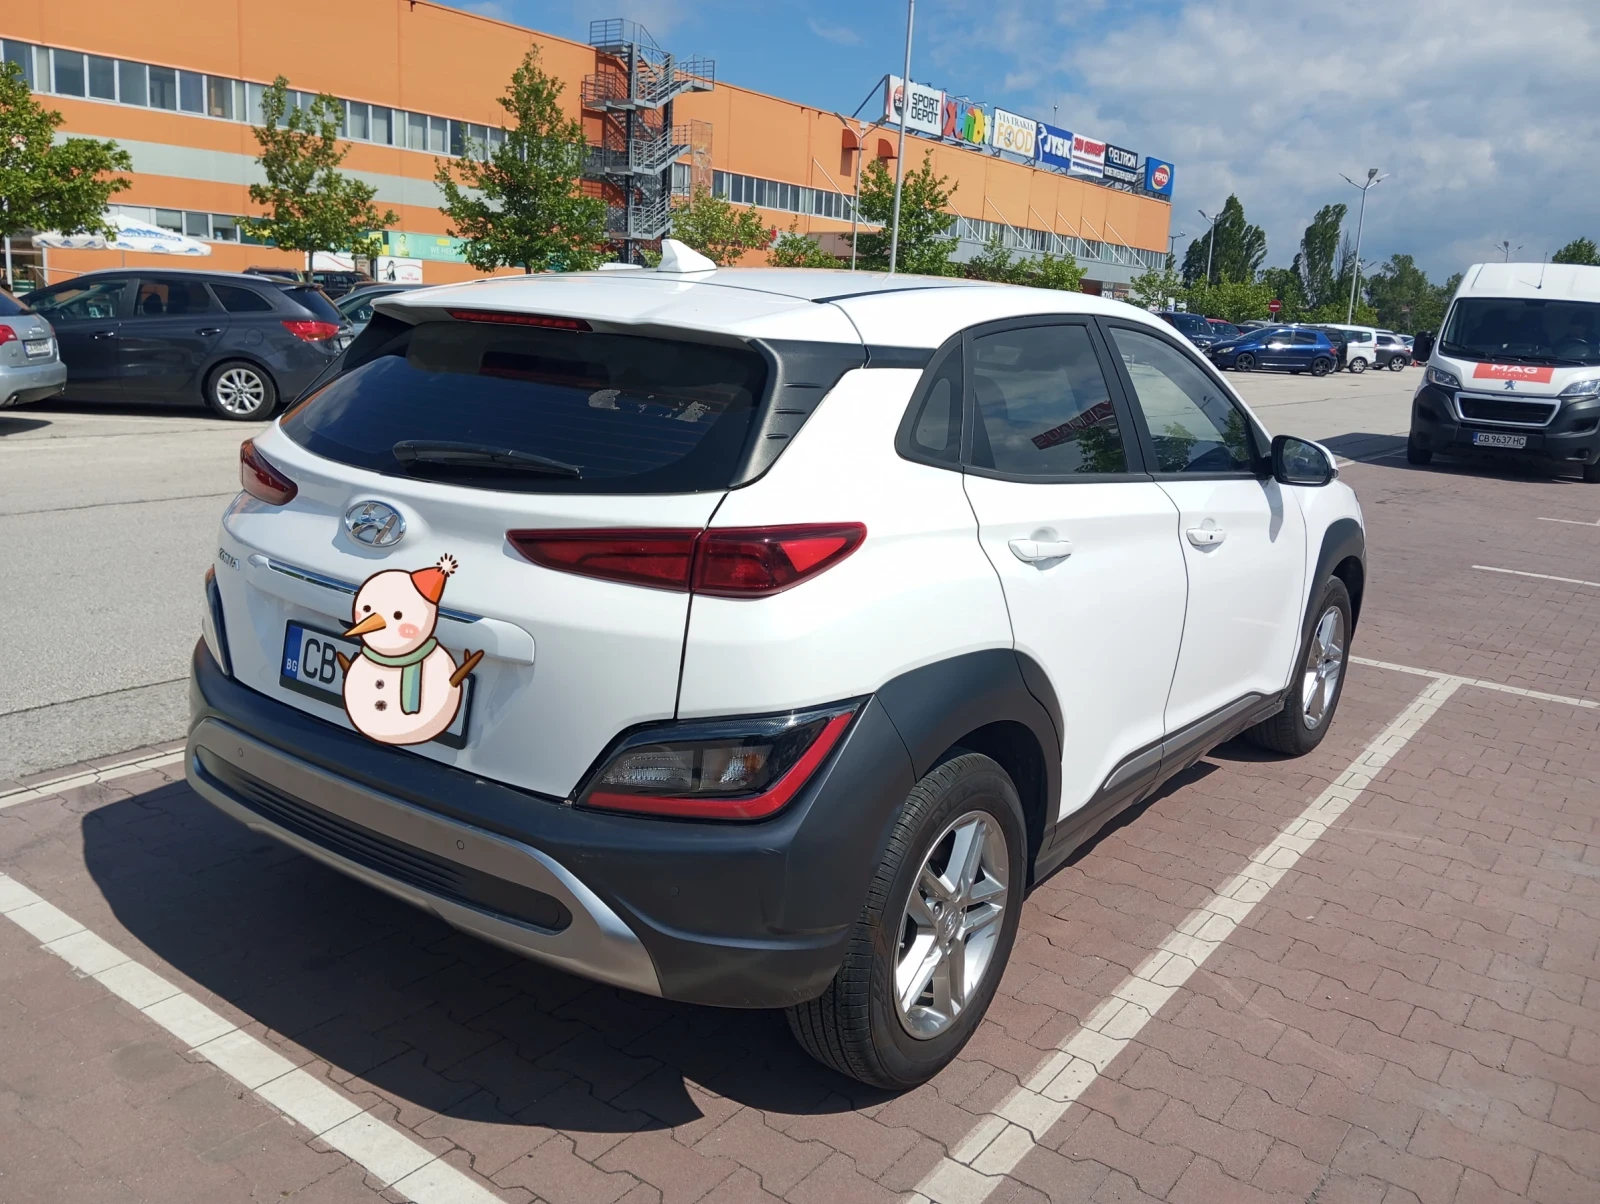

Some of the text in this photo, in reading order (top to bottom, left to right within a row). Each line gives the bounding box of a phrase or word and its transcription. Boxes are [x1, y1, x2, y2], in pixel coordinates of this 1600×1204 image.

[912, 92, 940, 112] SPORT
[910, 106, 938, 126] DEPOT
[998, 112, 1034, 132] VIA TRAKIA
[996, 122, 1033, 154] FOOD
[1043, 134, 1072, 160] JYSK
[1154, 171, 1168, 184] PEPCO
[1490, 365, 1537, 374] MAG
[1478, 434, 1525, 446] CB 9637 HC
[285, 638, 337, 685] BG CB
